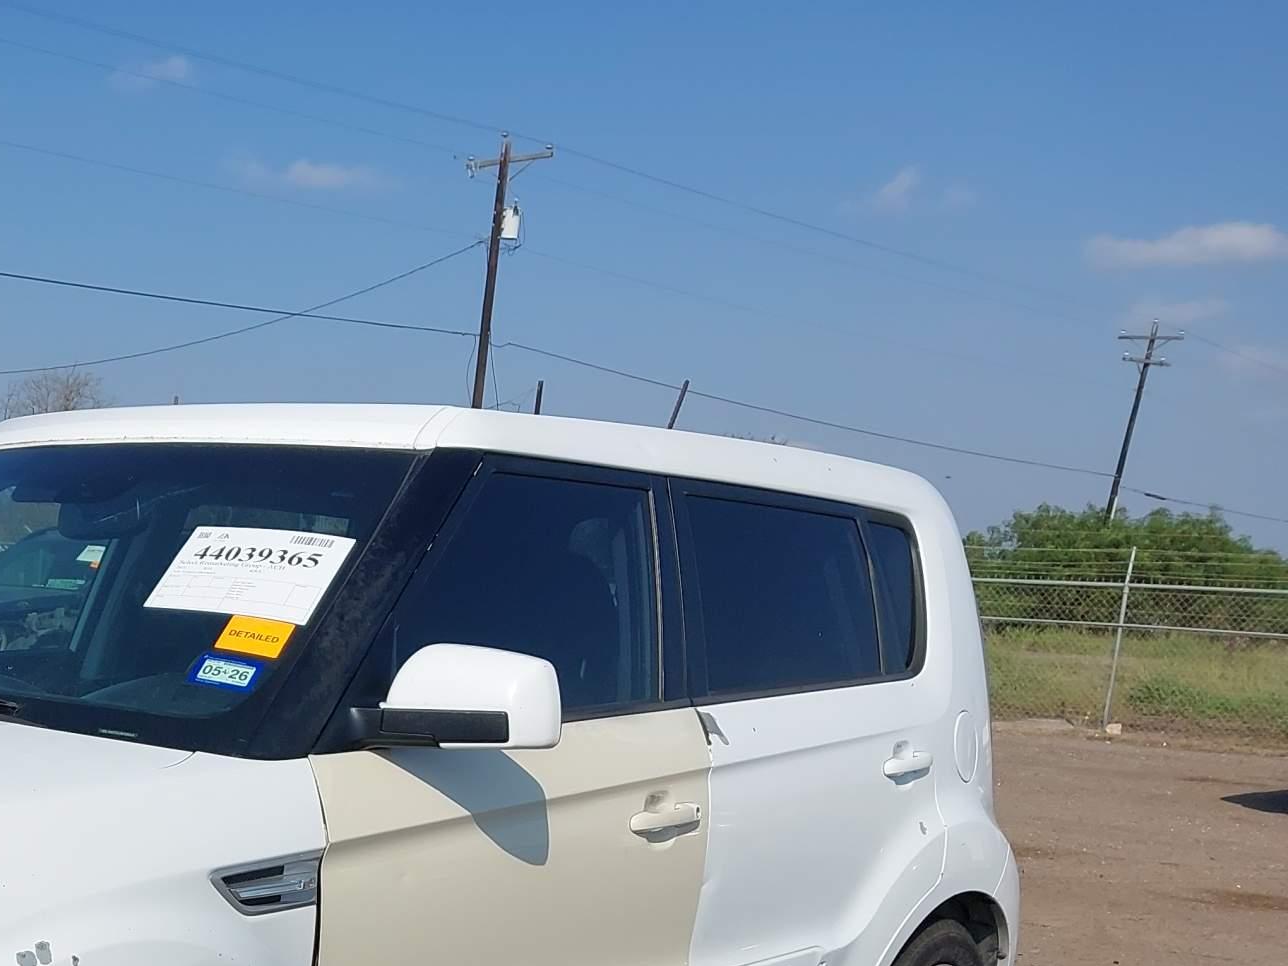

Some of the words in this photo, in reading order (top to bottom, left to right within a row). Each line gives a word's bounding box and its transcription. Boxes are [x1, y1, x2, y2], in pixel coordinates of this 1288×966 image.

[194, 545, 323, 569] 44039365
[228, 628, 280, 645] DETAILED
[202, 664, 223, 676] 05
[228, 668, 250, 681] 26
